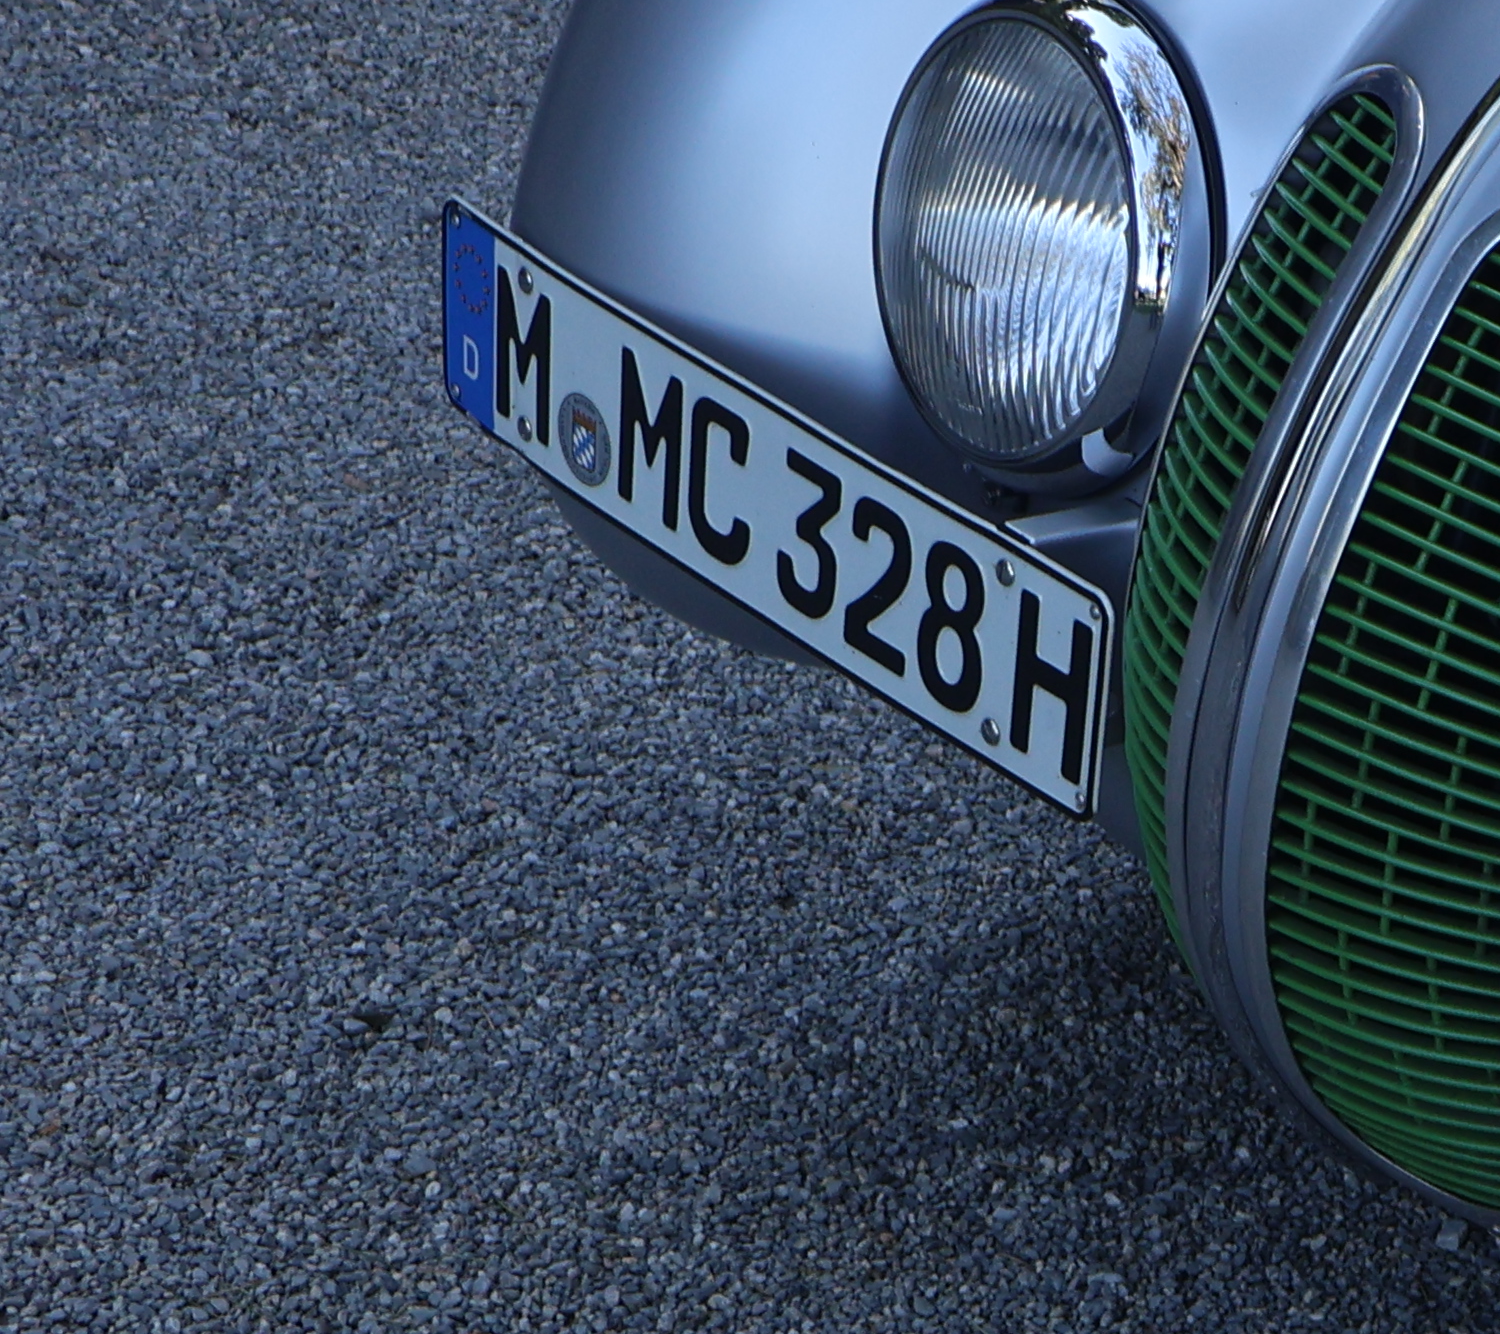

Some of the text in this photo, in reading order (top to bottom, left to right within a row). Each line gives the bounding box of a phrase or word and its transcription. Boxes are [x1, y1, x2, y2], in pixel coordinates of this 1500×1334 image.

[462, 334, 481, 380] D
[496, 264, 551, 447] M
[617, 346, 751, 566] MC
